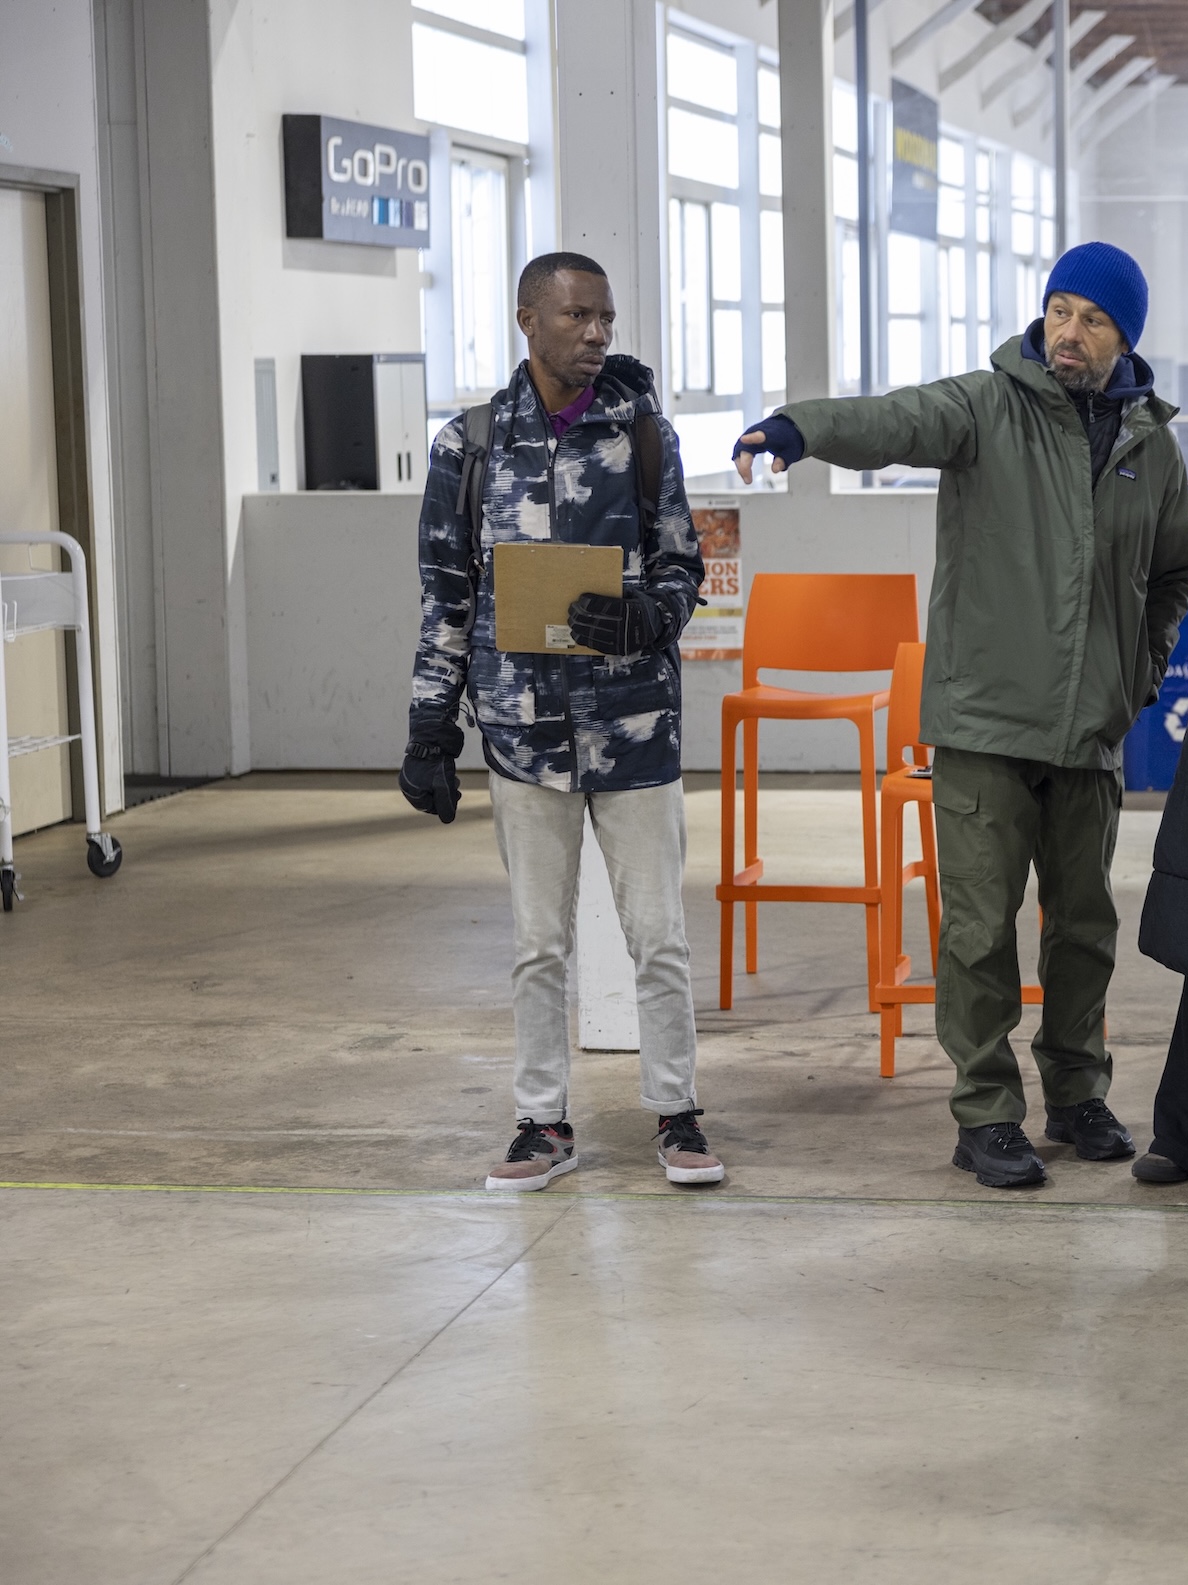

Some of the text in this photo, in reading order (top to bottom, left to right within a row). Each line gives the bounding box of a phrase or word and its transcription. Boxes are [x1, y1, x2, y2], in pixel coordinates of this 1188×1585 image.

[327, 136, 428, 194] GoPro
[704, 562, 739, 577] ION
[698, 577, 739, 596] ERS
